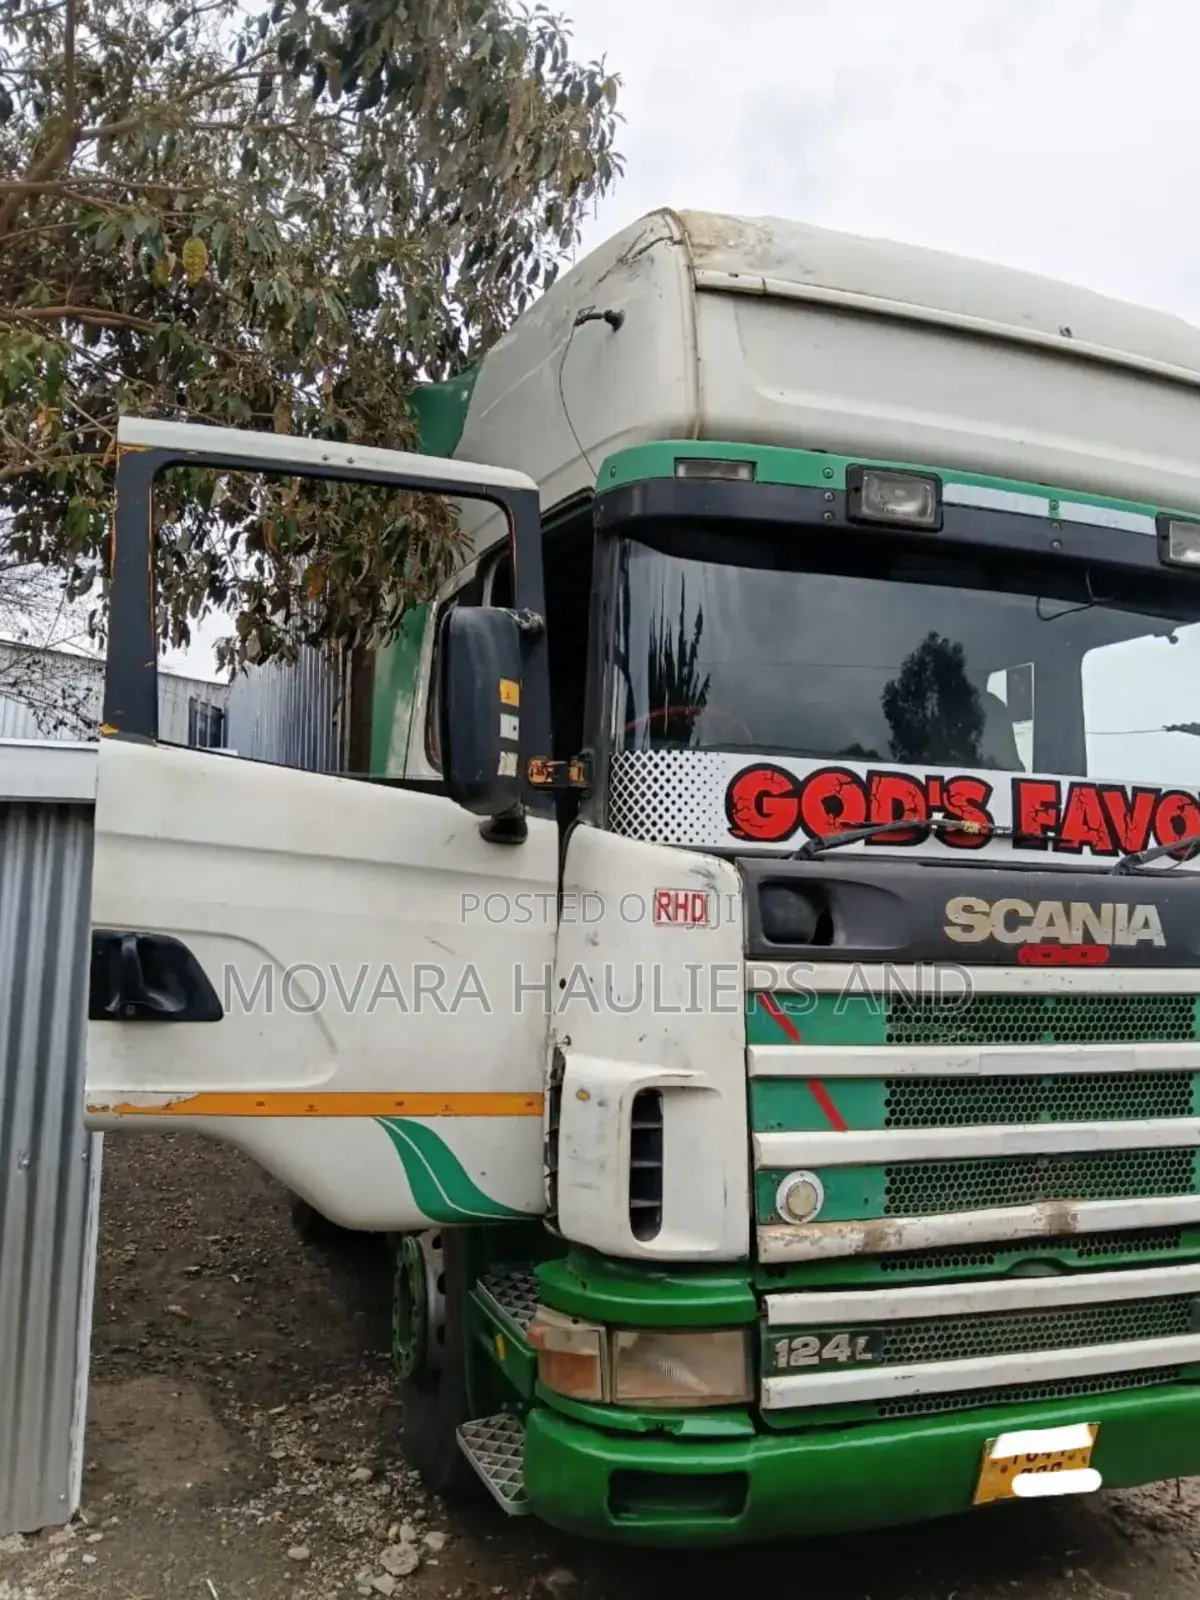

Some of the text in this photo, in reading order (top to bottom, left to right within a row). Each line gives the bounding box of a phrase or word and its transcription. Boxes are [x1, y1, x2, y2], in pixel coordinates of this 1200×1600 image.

[725, 762, 1200, 861] GOD'S FAVO
[656, 892, 705, 922] RHD
[943, 897, 1167, 947] SCANIA
